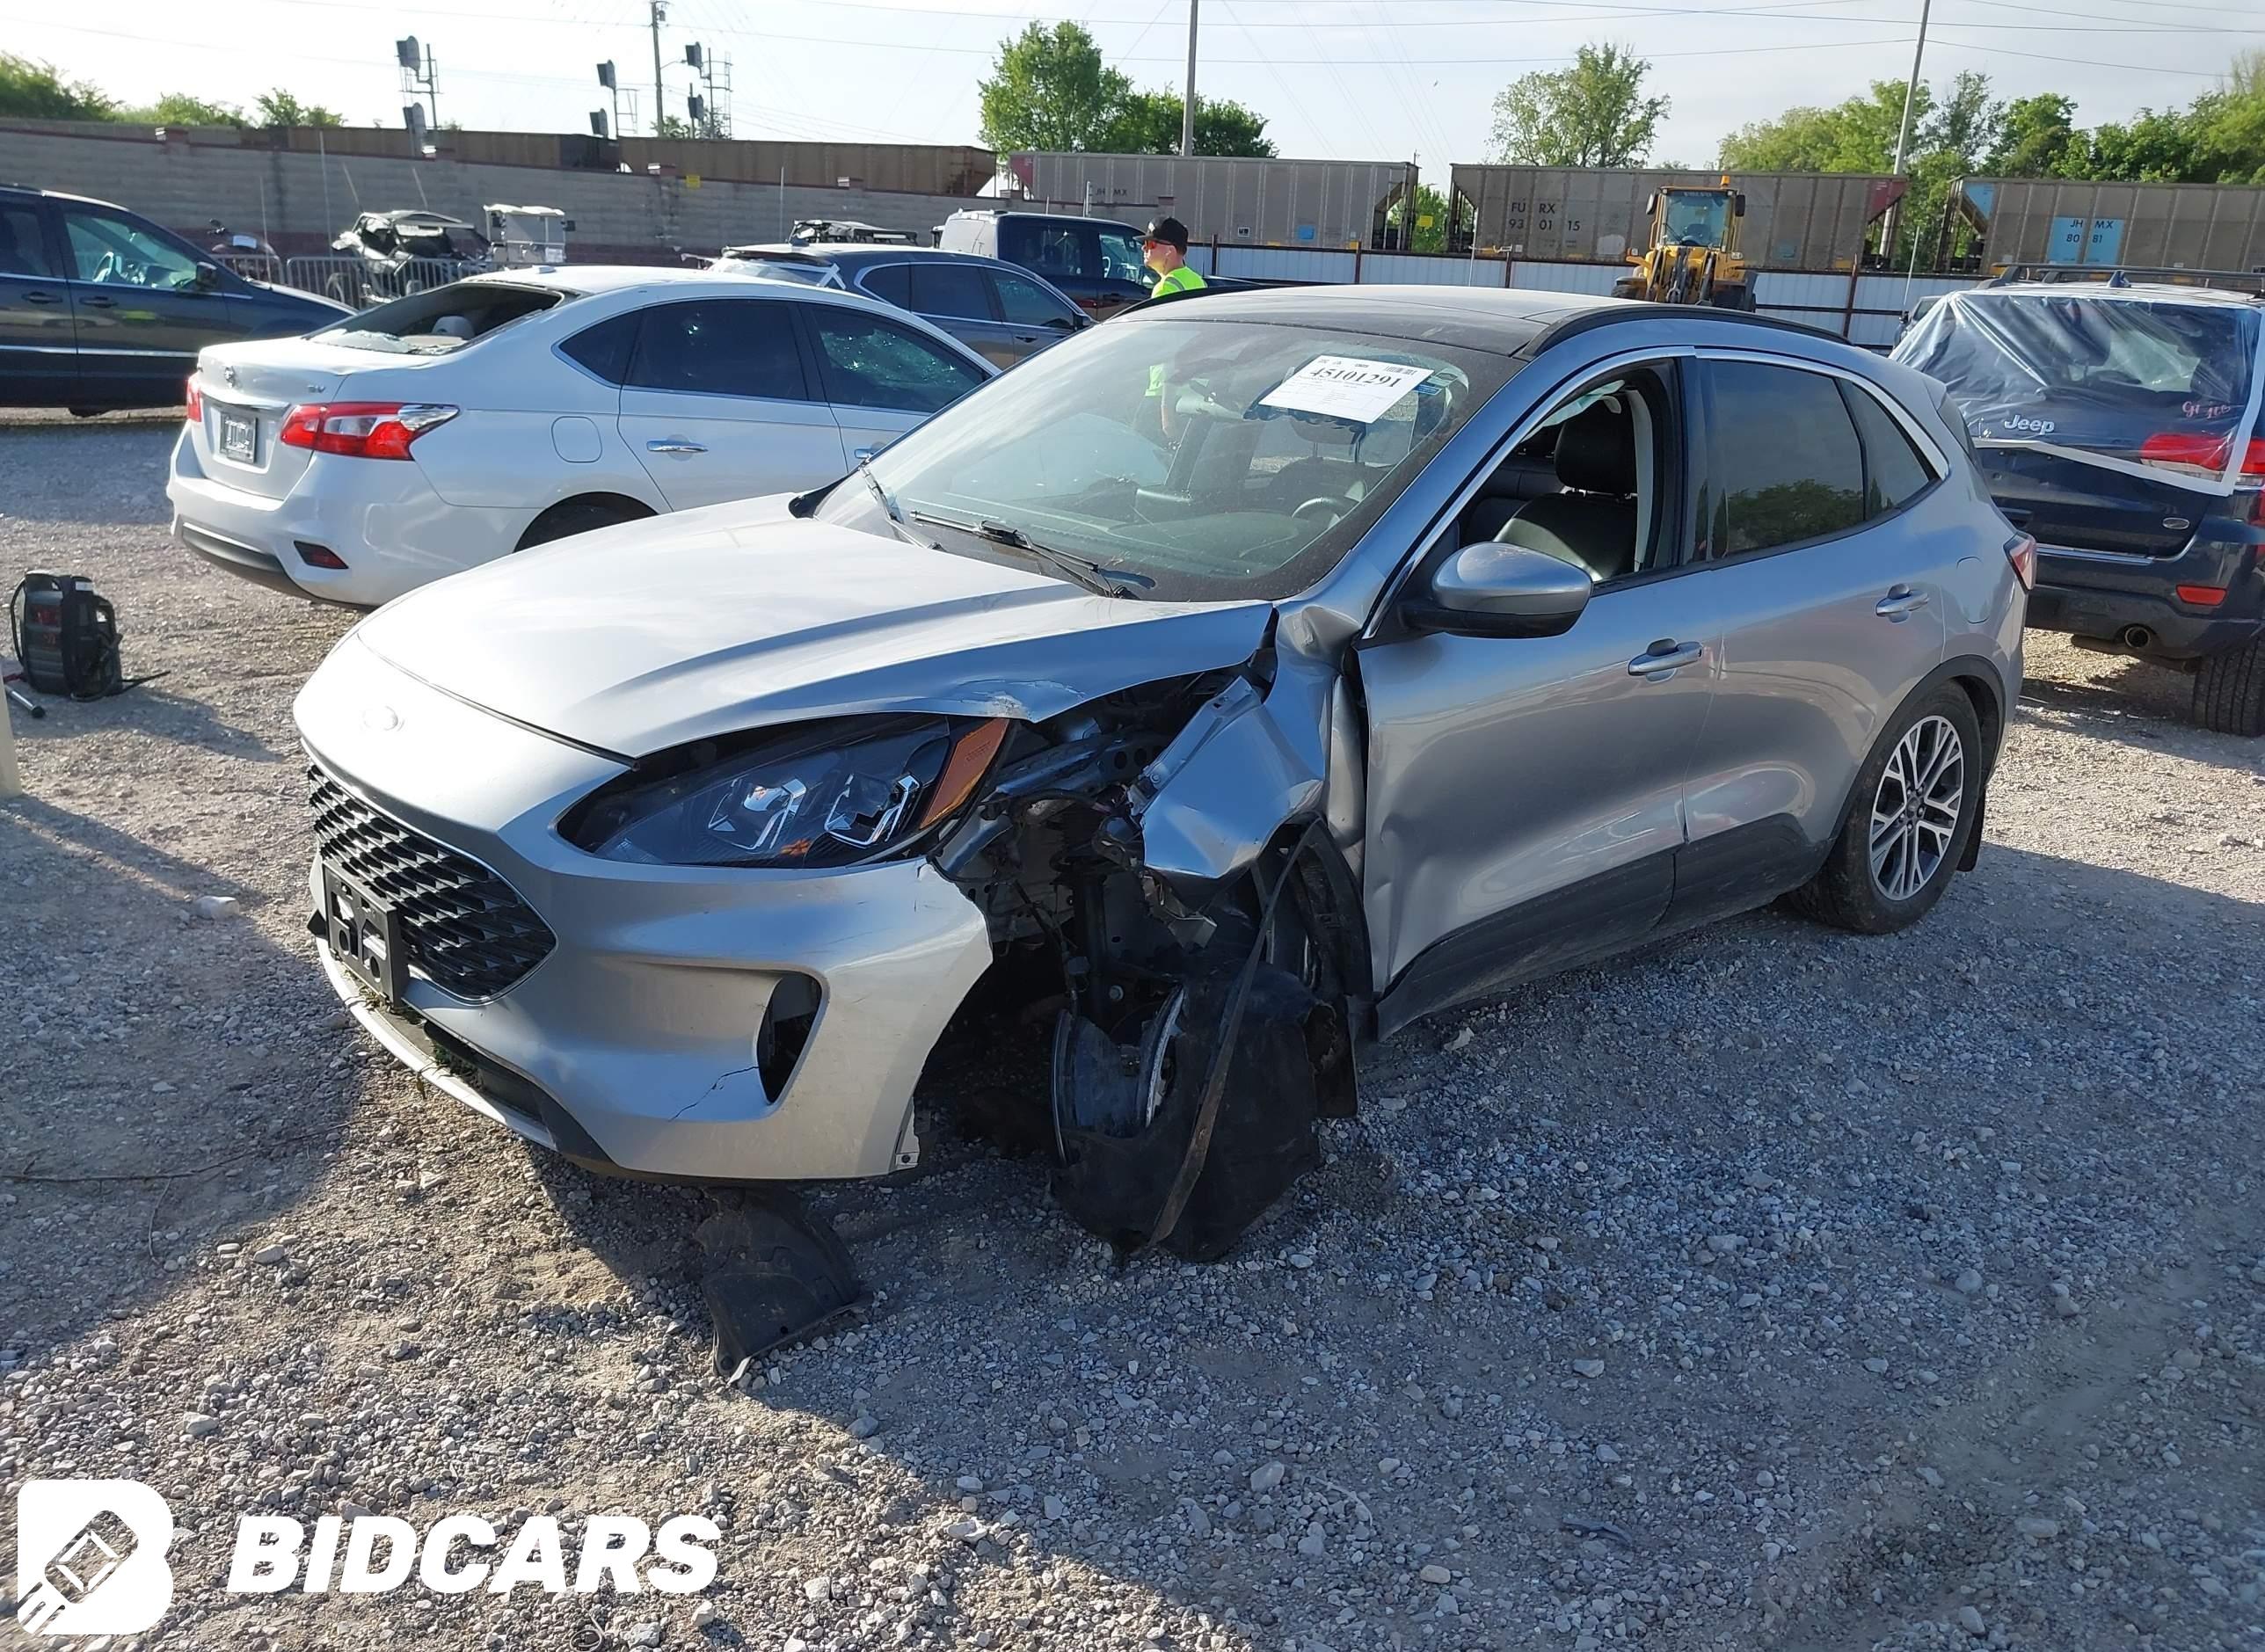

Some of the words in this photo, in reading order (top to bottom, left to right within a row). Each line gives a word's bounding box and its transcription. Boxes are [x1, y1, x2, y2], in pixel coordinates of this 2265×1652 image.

[1511, 202, 1526, 213] FU
[1539, 203, 1555, 215] RX
[1509, 218, 1524, 229] 93
[1539, 219, 1553, 230] 01
[1568, 220, 1580, 231] 15
[2070, 219, 2084, 229] JH
[2094, 220, 2114, 229] MX
[2066, 234, 2080, 243] 80
[1310, 367, 1402, 387] 45101291
[2004, 414, 2055, 435] Jeep
